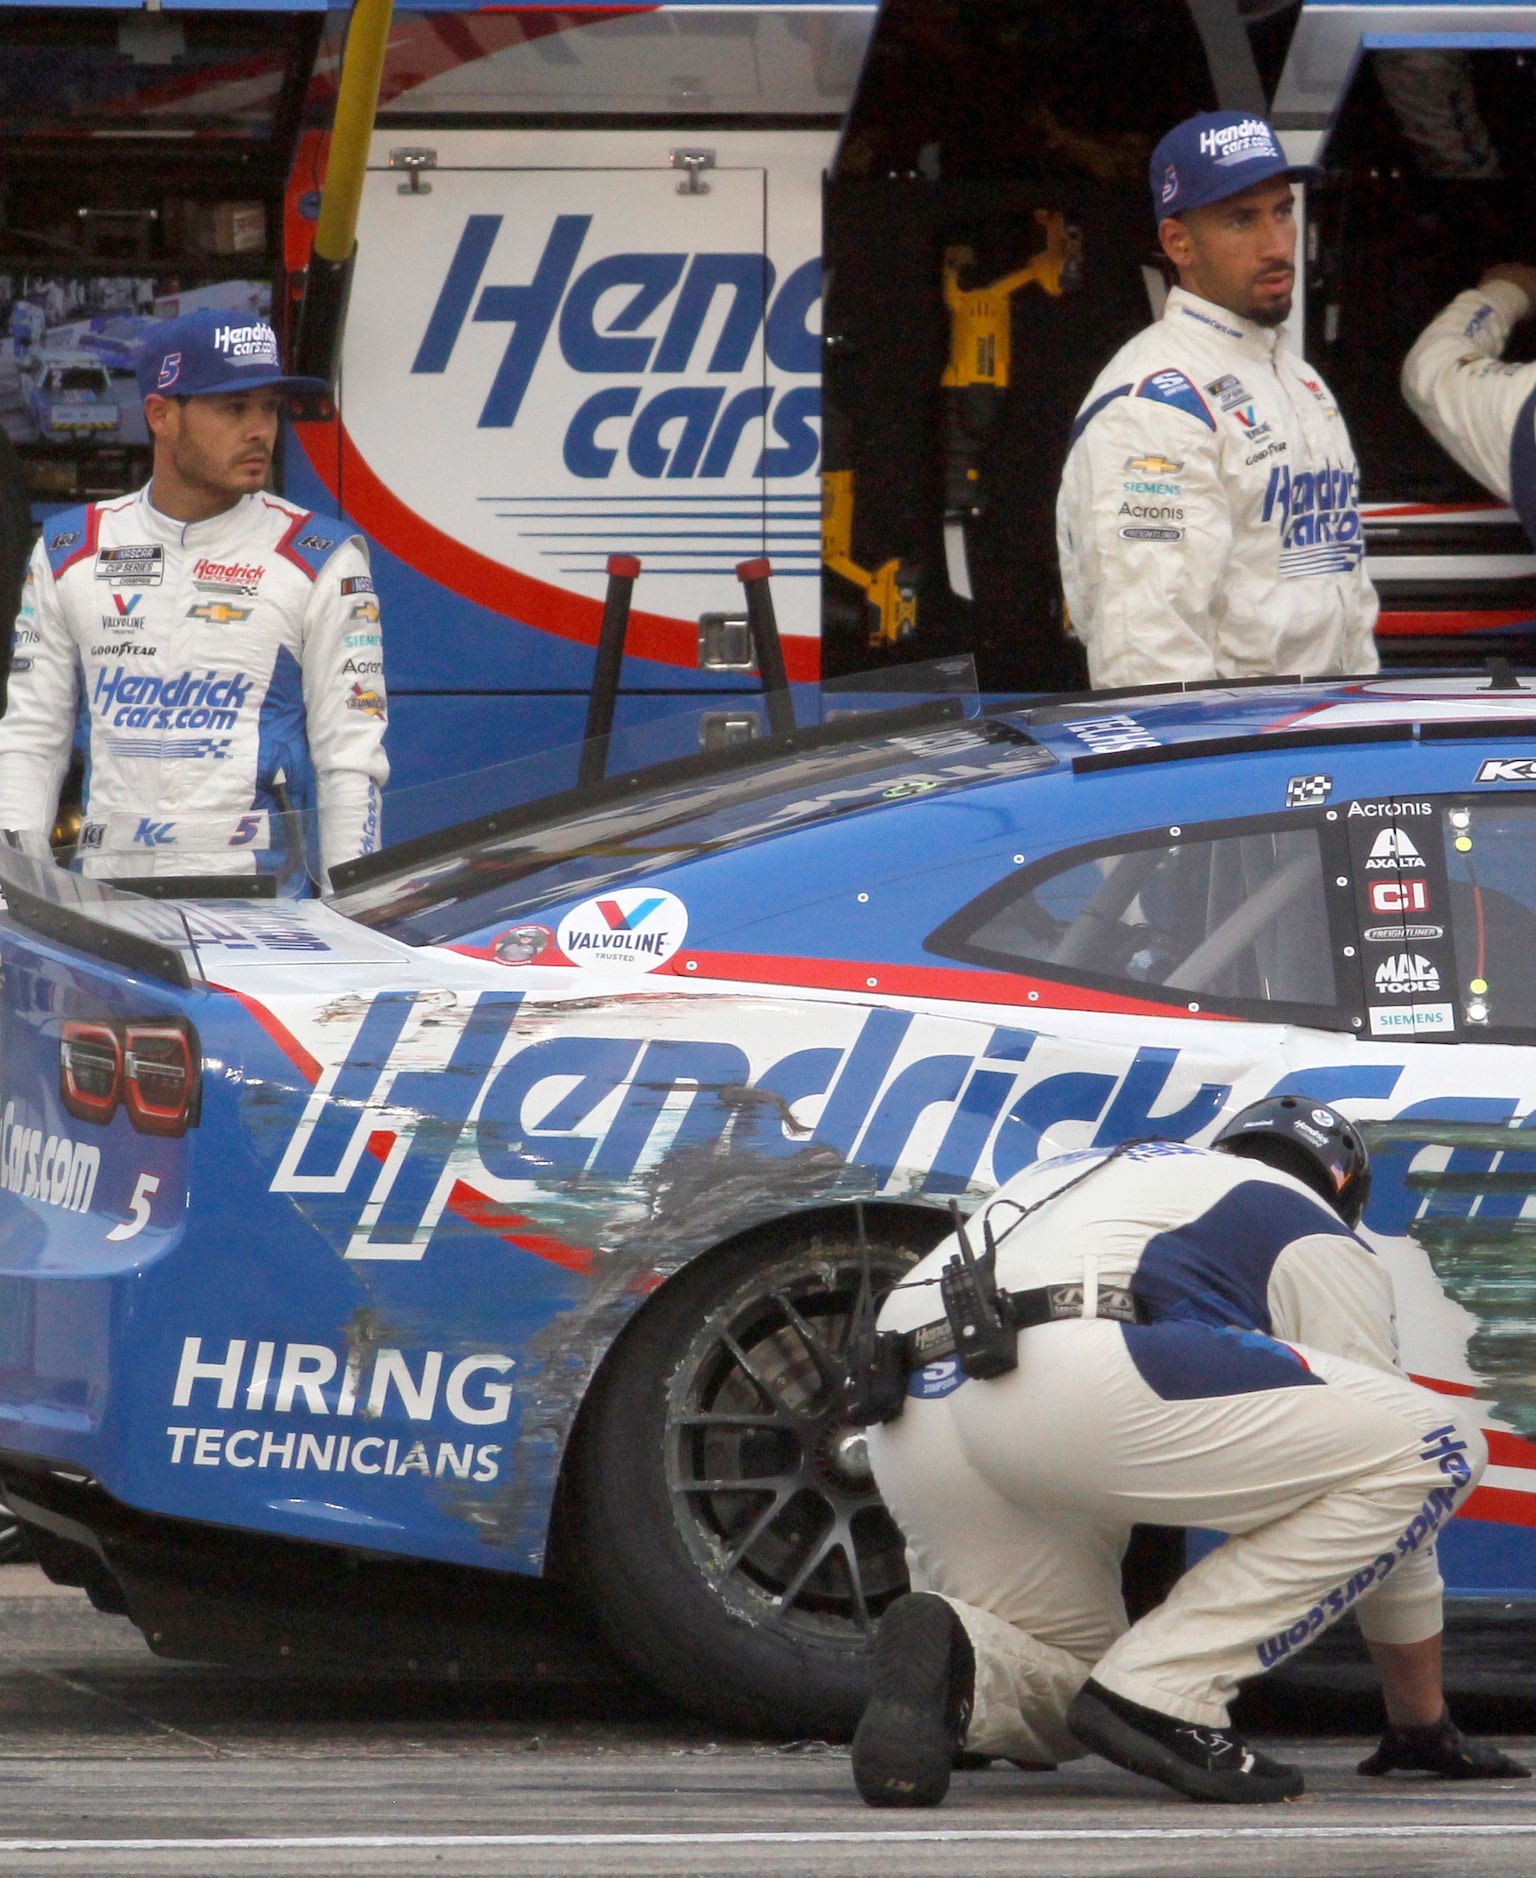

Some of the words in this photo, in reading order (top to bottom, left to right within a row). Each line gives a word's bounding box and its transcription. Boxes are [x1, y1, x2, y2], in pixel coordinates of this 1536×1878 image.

[1162, 164, 1179, 204] 5
[157, 351, 182, 390] 5
[562, 385, 823, 478] cars
[1122, 481, 1182, 496] SIEMENS
[1117, 501, 1185, 521] Acronis
[116, 549, 155, 559] NASCAR
[105, 563, 124, 573] CUP
[123, 562, 154, 573] SERIES
[191, 558, 267, 581] Hendrick
[101, 614, 147, 631] VALVOLINE
[90, 641, 158, 658] GOODYEAR
[93, 666, 255, 717] Hendrick
[112, 704, 239, 731] cars.com
[1063, 714, 1162, 755] TECHS
[1347, 800, 1433, 818] Acronis
[227, 815, 262, 847] 5
[1365, 856, 1427, 869] AXALTA
[1372, 882, 1427, 911] CI
[567, 929, 670, 957] VALVOLINE
[1371, 928, 1437, 939] FREIGHTLINER
[595, 952, 635, 963] TRUSTED
[1375, 953, 1440, 983] MAC
[1375, 980, 1441, 994] TOOLS
[1379, 1011, 1444, 1026] SIEMENS
[105, 1171, 161, 1242] 5
[172, 1336, 517, 1426] HIRING
[922, 1375, 958, 1394] SIMPSON
[165, 1425, 504, 1484] TECHNICIANS
